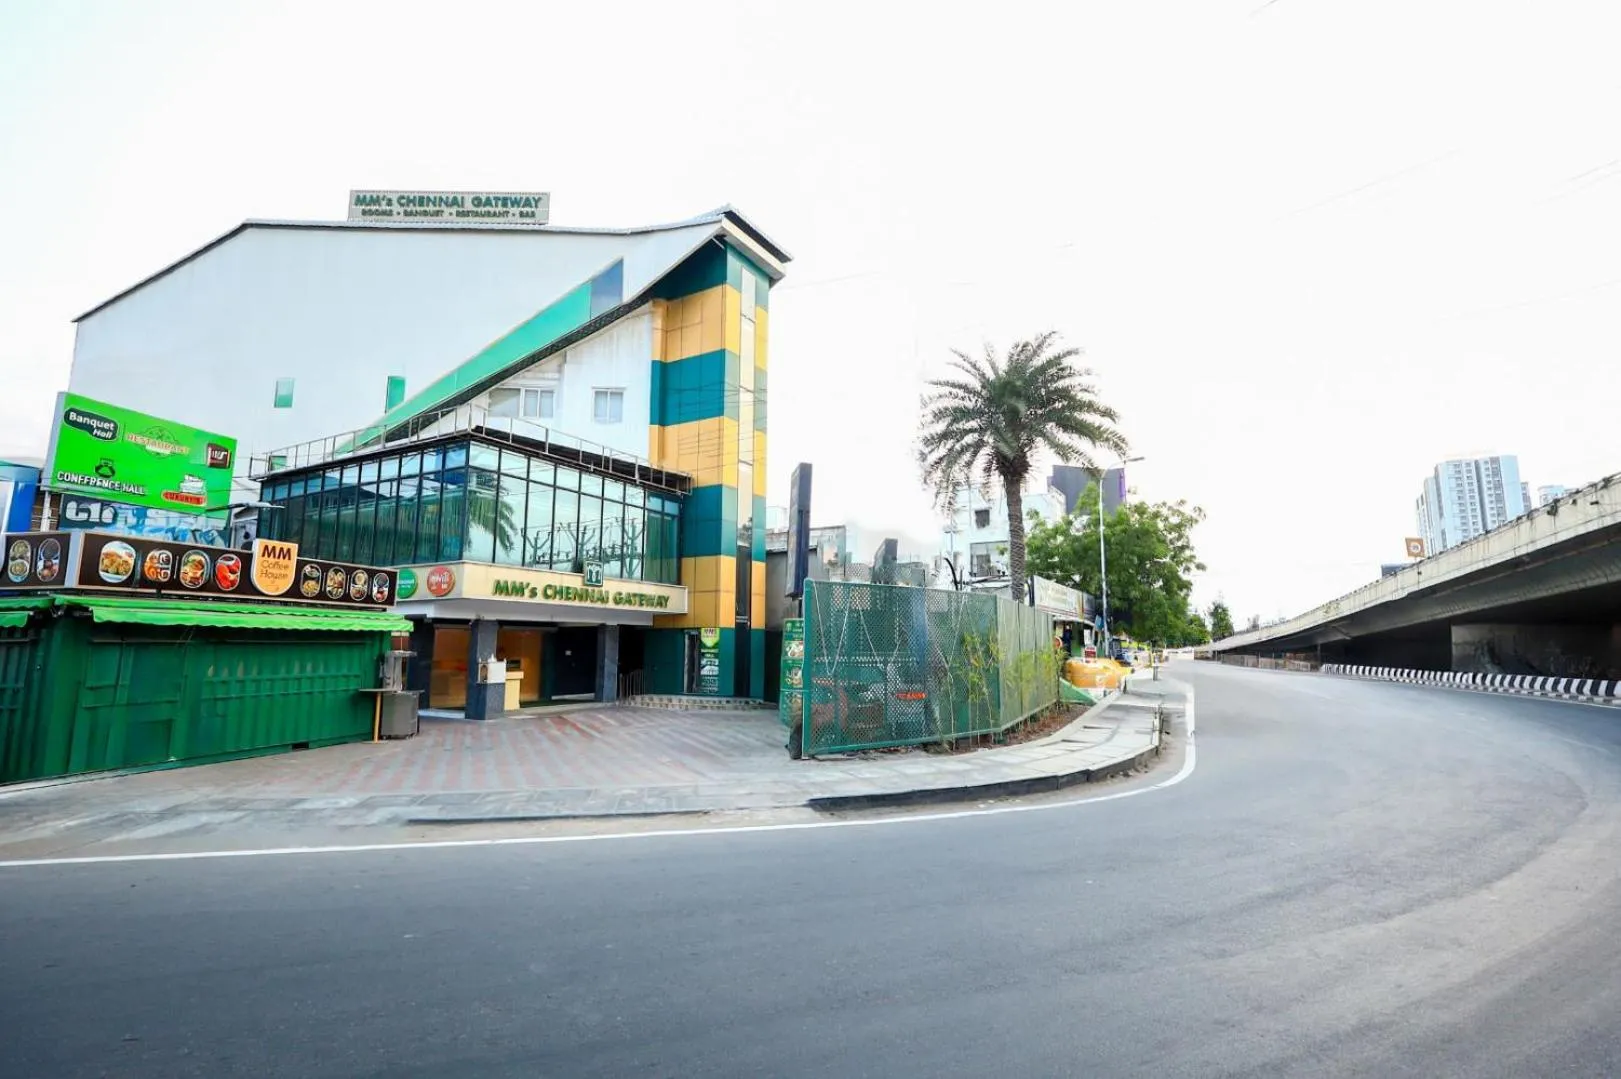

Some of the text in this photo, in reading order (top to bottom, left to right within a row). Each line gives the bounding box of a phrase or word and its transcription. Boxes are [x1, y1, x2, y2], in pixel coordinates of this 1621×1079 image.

[397, 195, 464, 208] CHENNAI
[471, 196, 542, 209] GATEWAY
[69, 411, 115, 430] Banquet
[93, 428, 113, 439] Hall
[261, 545, 291, 560] MM
[261, 560, 289, 570] Coffee
[260, 569, 289, 580] House
[493, 579, 670, 608] MM's CHENNAI GATEWAY
